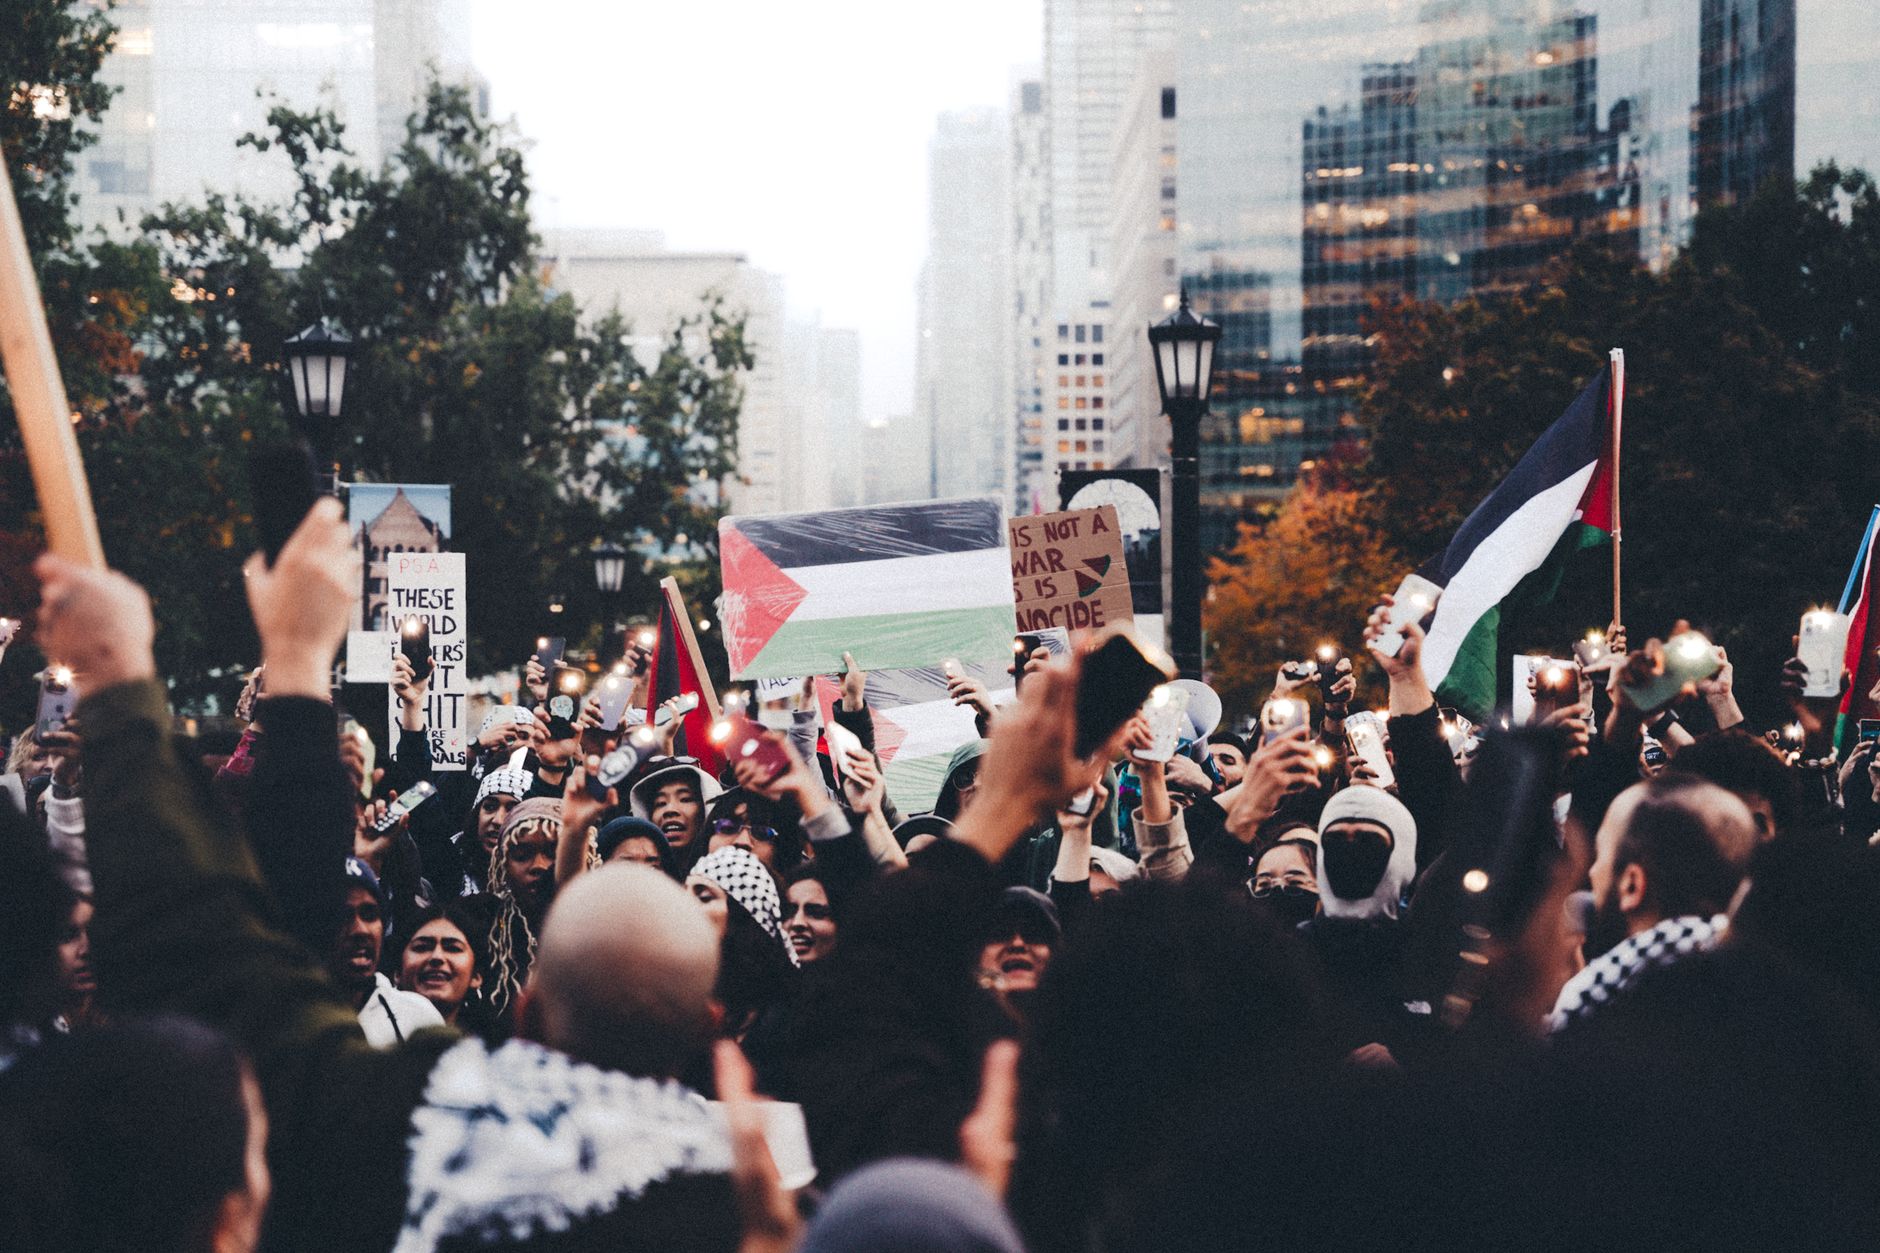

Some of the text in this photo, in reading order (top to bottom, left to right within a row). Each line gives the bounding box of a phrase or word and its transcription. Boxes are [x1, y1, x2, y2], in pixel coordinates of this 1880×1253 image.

[1012, 513, 1110, 548] IS NOT A
[1012, 548, 1067, 578] WAR
[392, 588, 455, 610] THESE
[1034, 577, 1057, 599] IS
[1016, 600, 1105, 633] NOCIDE
